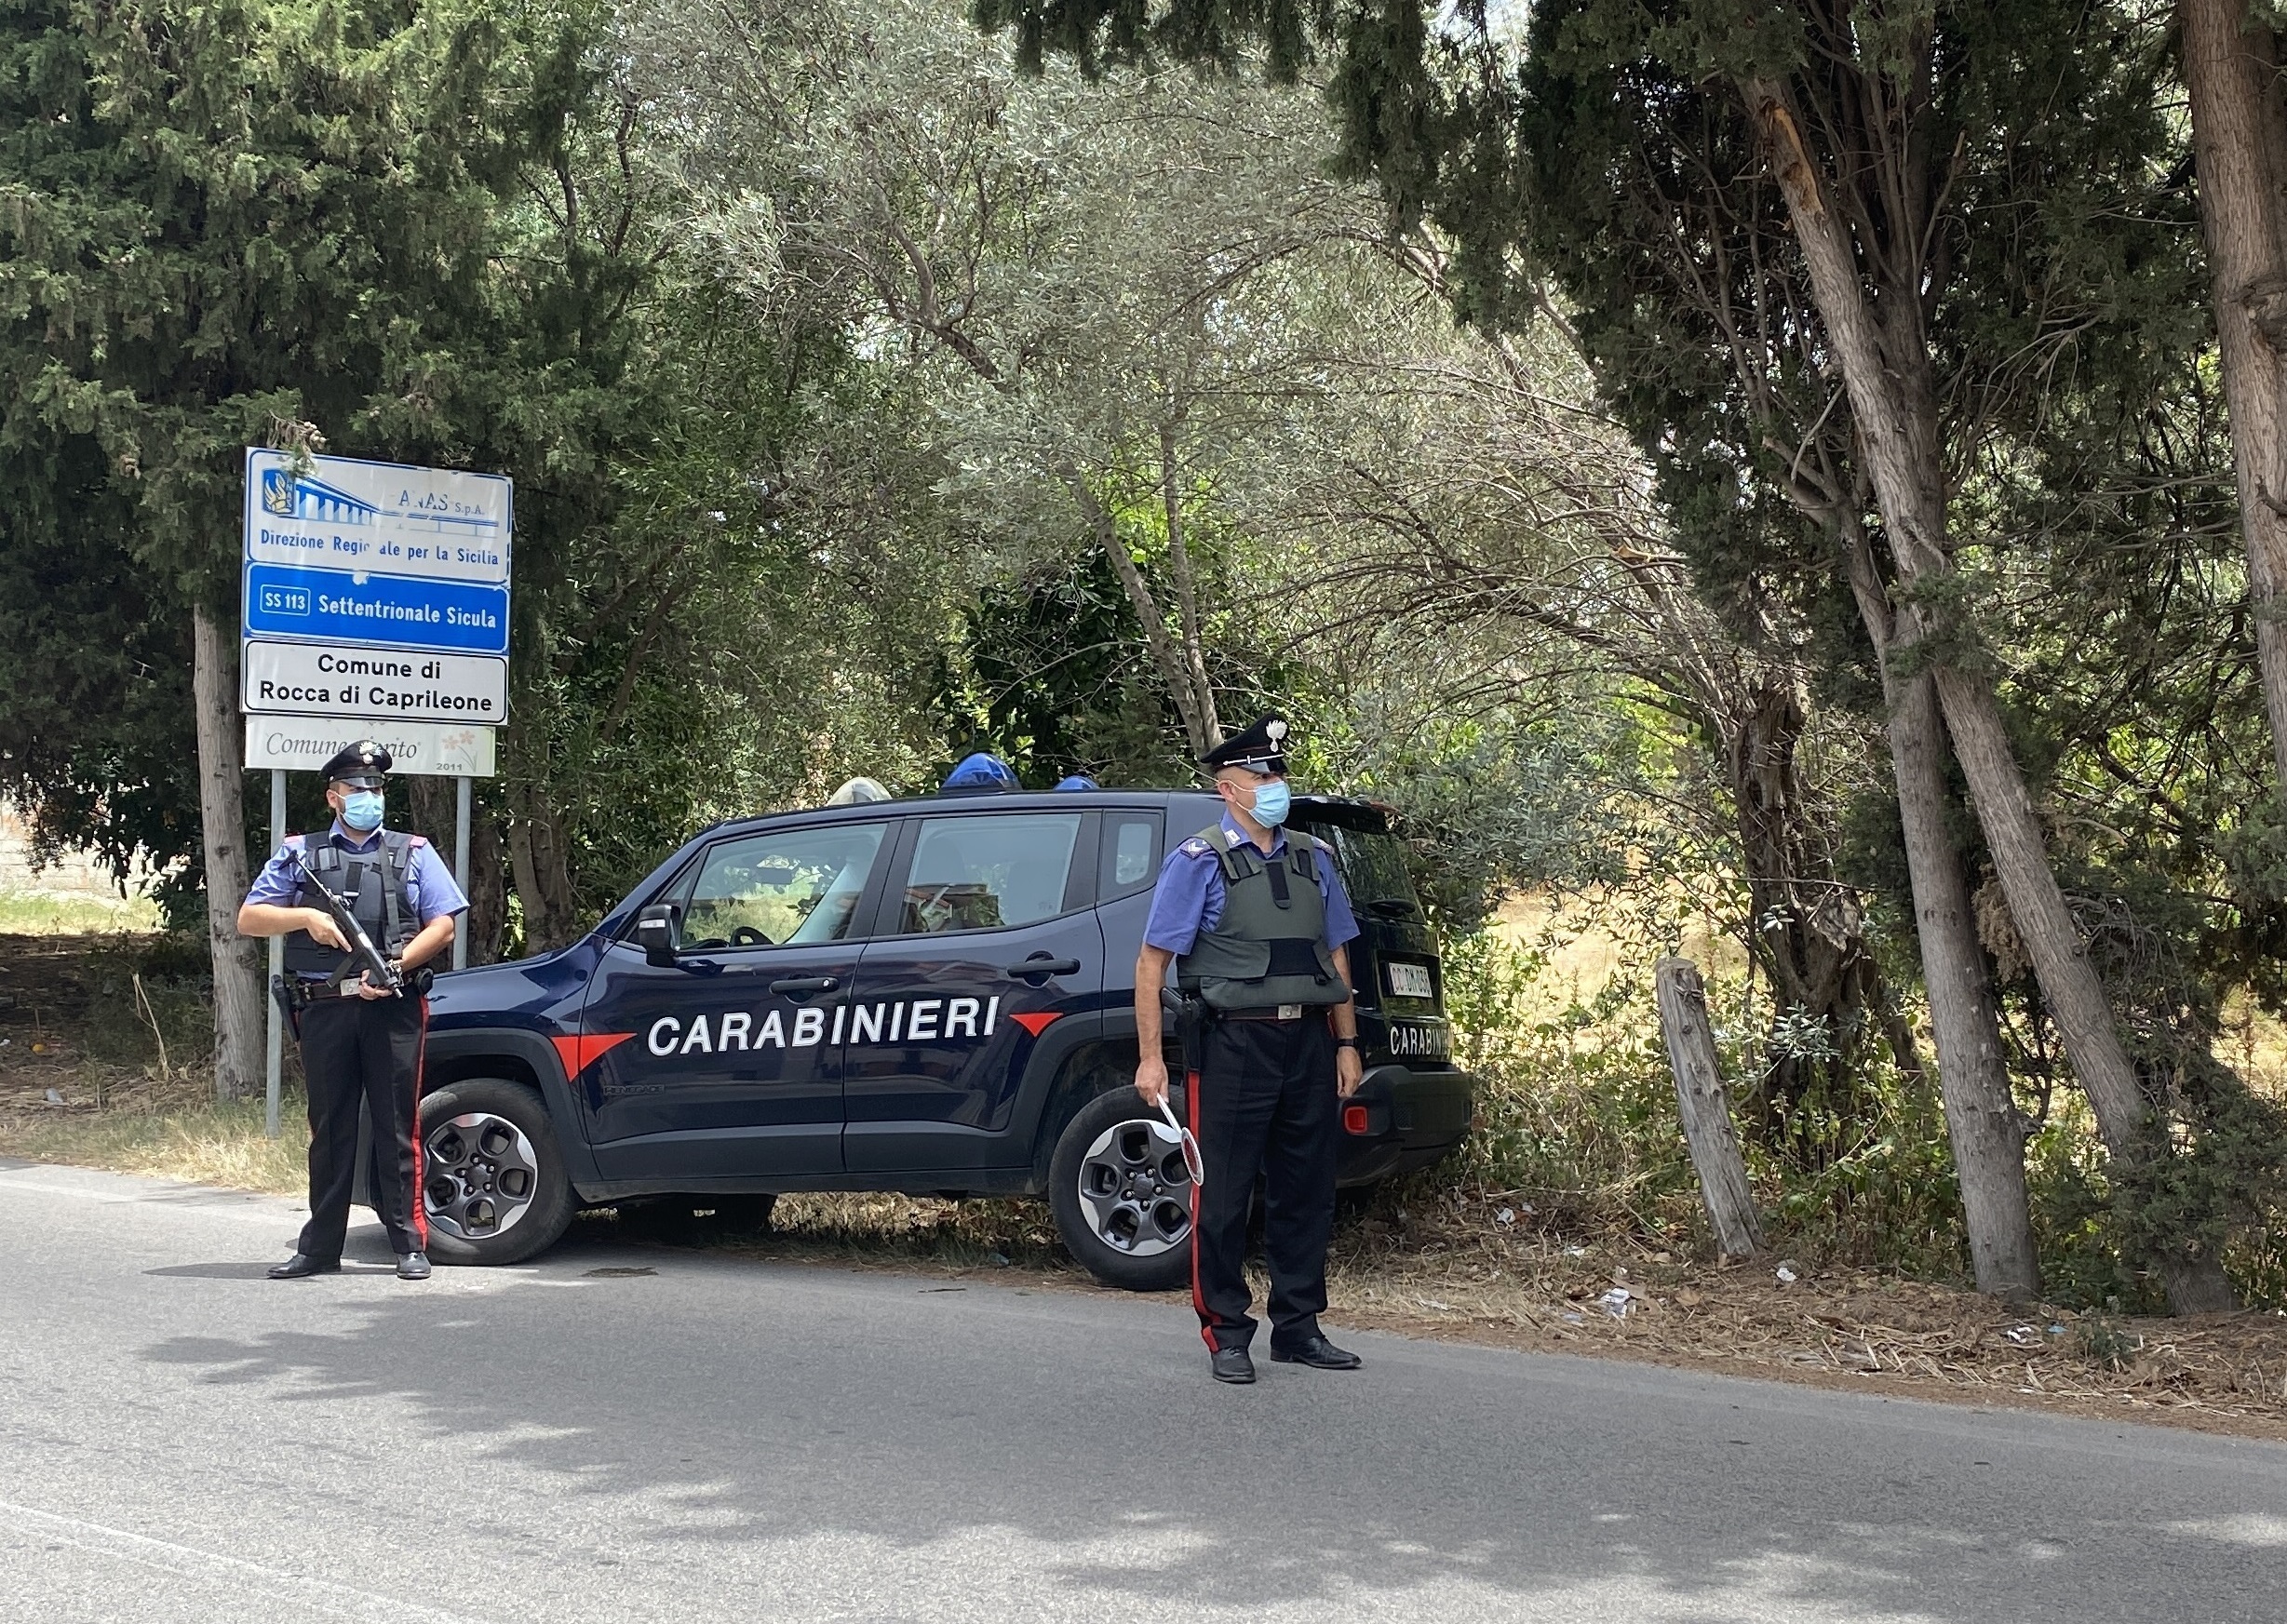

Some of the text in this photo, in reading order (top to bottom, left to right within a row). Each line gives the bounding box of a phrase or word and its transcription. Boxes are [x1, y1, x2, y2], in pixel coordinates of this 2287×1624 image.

[454, 503, 486, 516] S.p.A.
[261, 529, 499, 565] Direzione Regiale per la Sicilia
[265, 593, 496, 628] SS 113 Settentrionale Sicula
[317, 654, 441, 678] Comune di
[260, 680, 492, 711] Rocca di Caprileone
[266, 732, 417, 758] Comune rito
[436, 762, 463, 772] 2011
[648, 996, 1001, 1056] CARABINIERI
